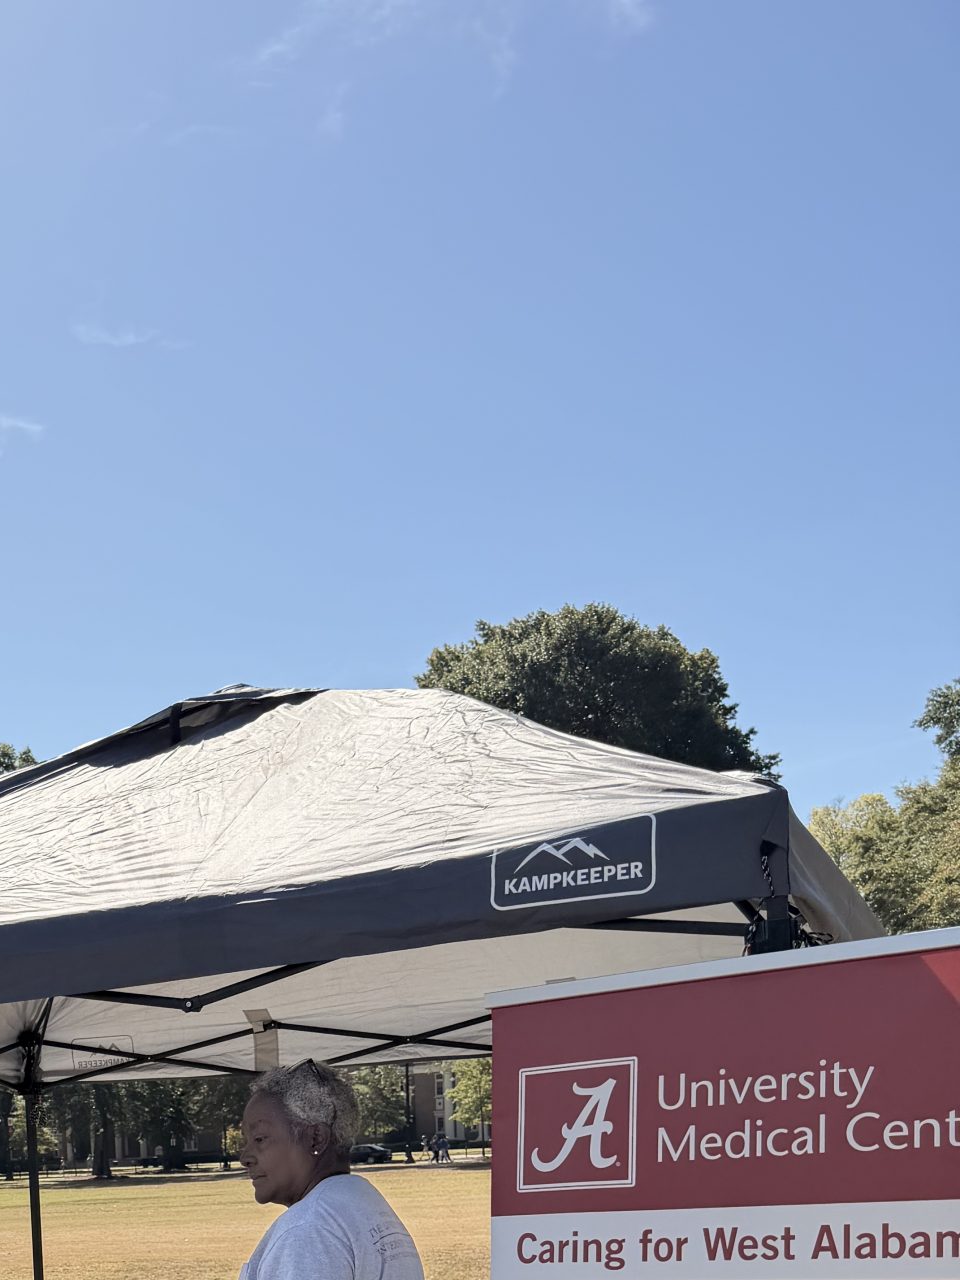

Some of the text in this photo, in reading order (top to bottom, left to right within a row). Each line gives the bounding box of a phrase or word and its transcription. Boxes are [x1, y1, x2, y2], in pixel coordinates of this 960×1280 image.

[504, 861, 643, 895] KAMPKEEPER
[658, 1059, 875, 1111] University
[657, 1108, 960, 1163] Medical Cent
[516, 1223, 960, 1270] Caring for West Alabam
